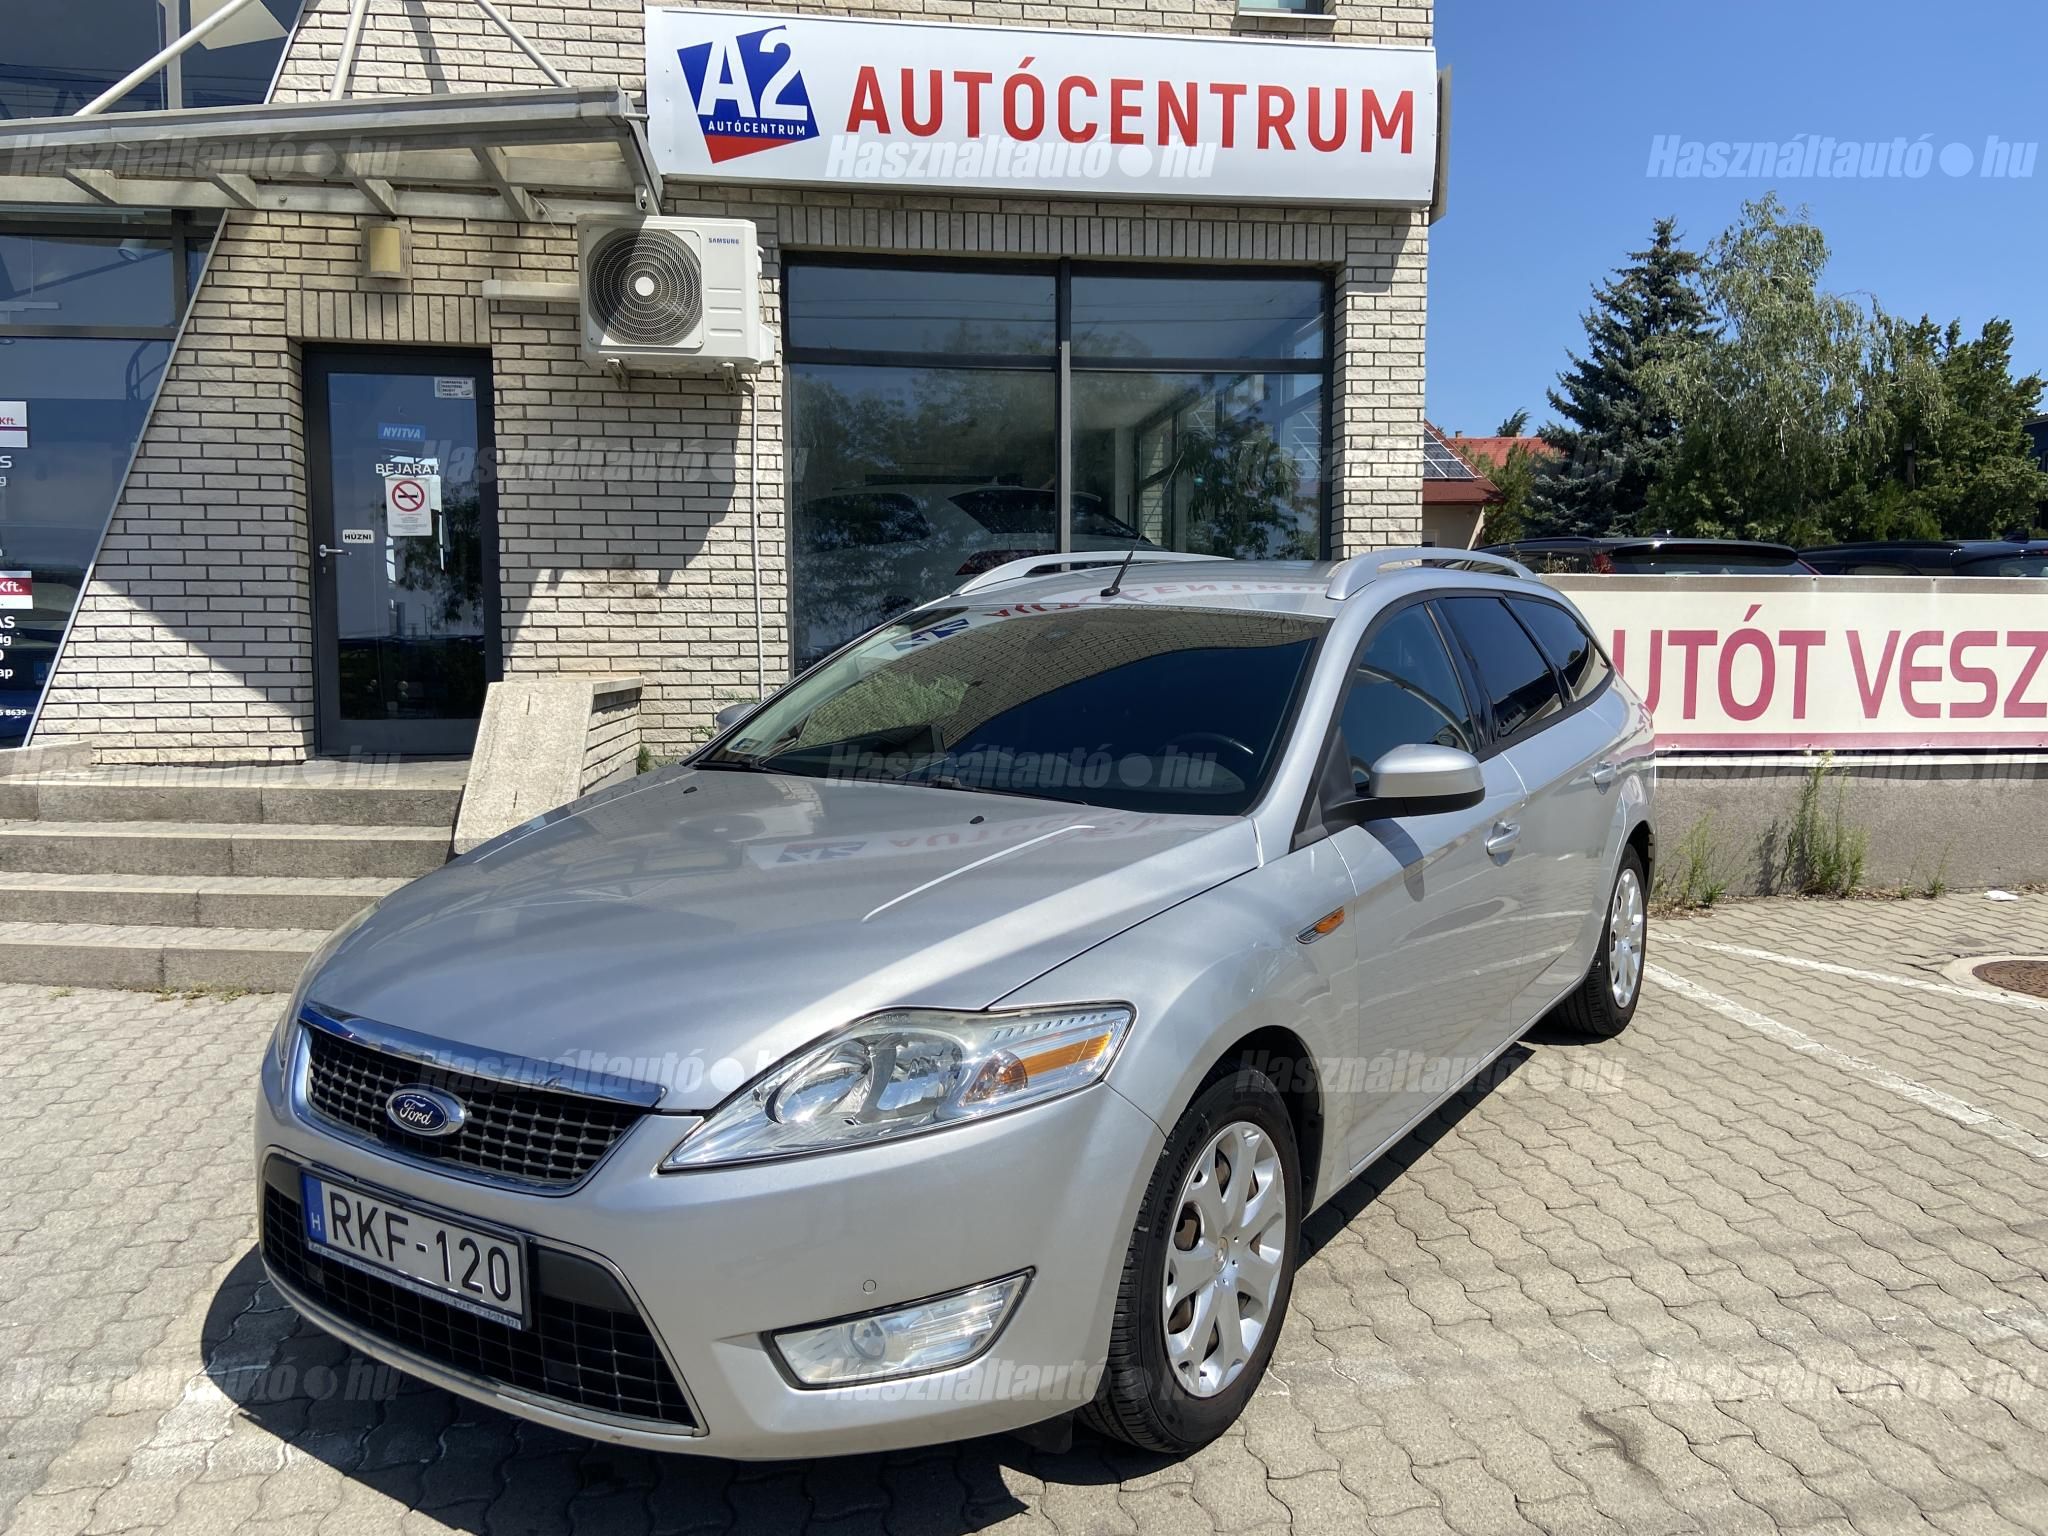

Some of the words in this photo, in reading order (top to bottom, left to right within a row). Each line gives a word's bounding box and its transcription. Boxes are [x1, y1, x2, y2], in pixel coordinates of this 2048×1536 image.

[697, 27, 808, 122] A2
[846, 54, 1415, 156] AUTÓCENTRUM
[708, 119, 806, 136] AUTÓCENTRUM
[382, 426, 422, 440] NYITVA
[1611, 604, 1826, 722] UTÓT
[399, 1099, 434, 1125] Ford
[310, 1211, 322, 1232] H
[329, 1190, 512, 1302] RKF-120
